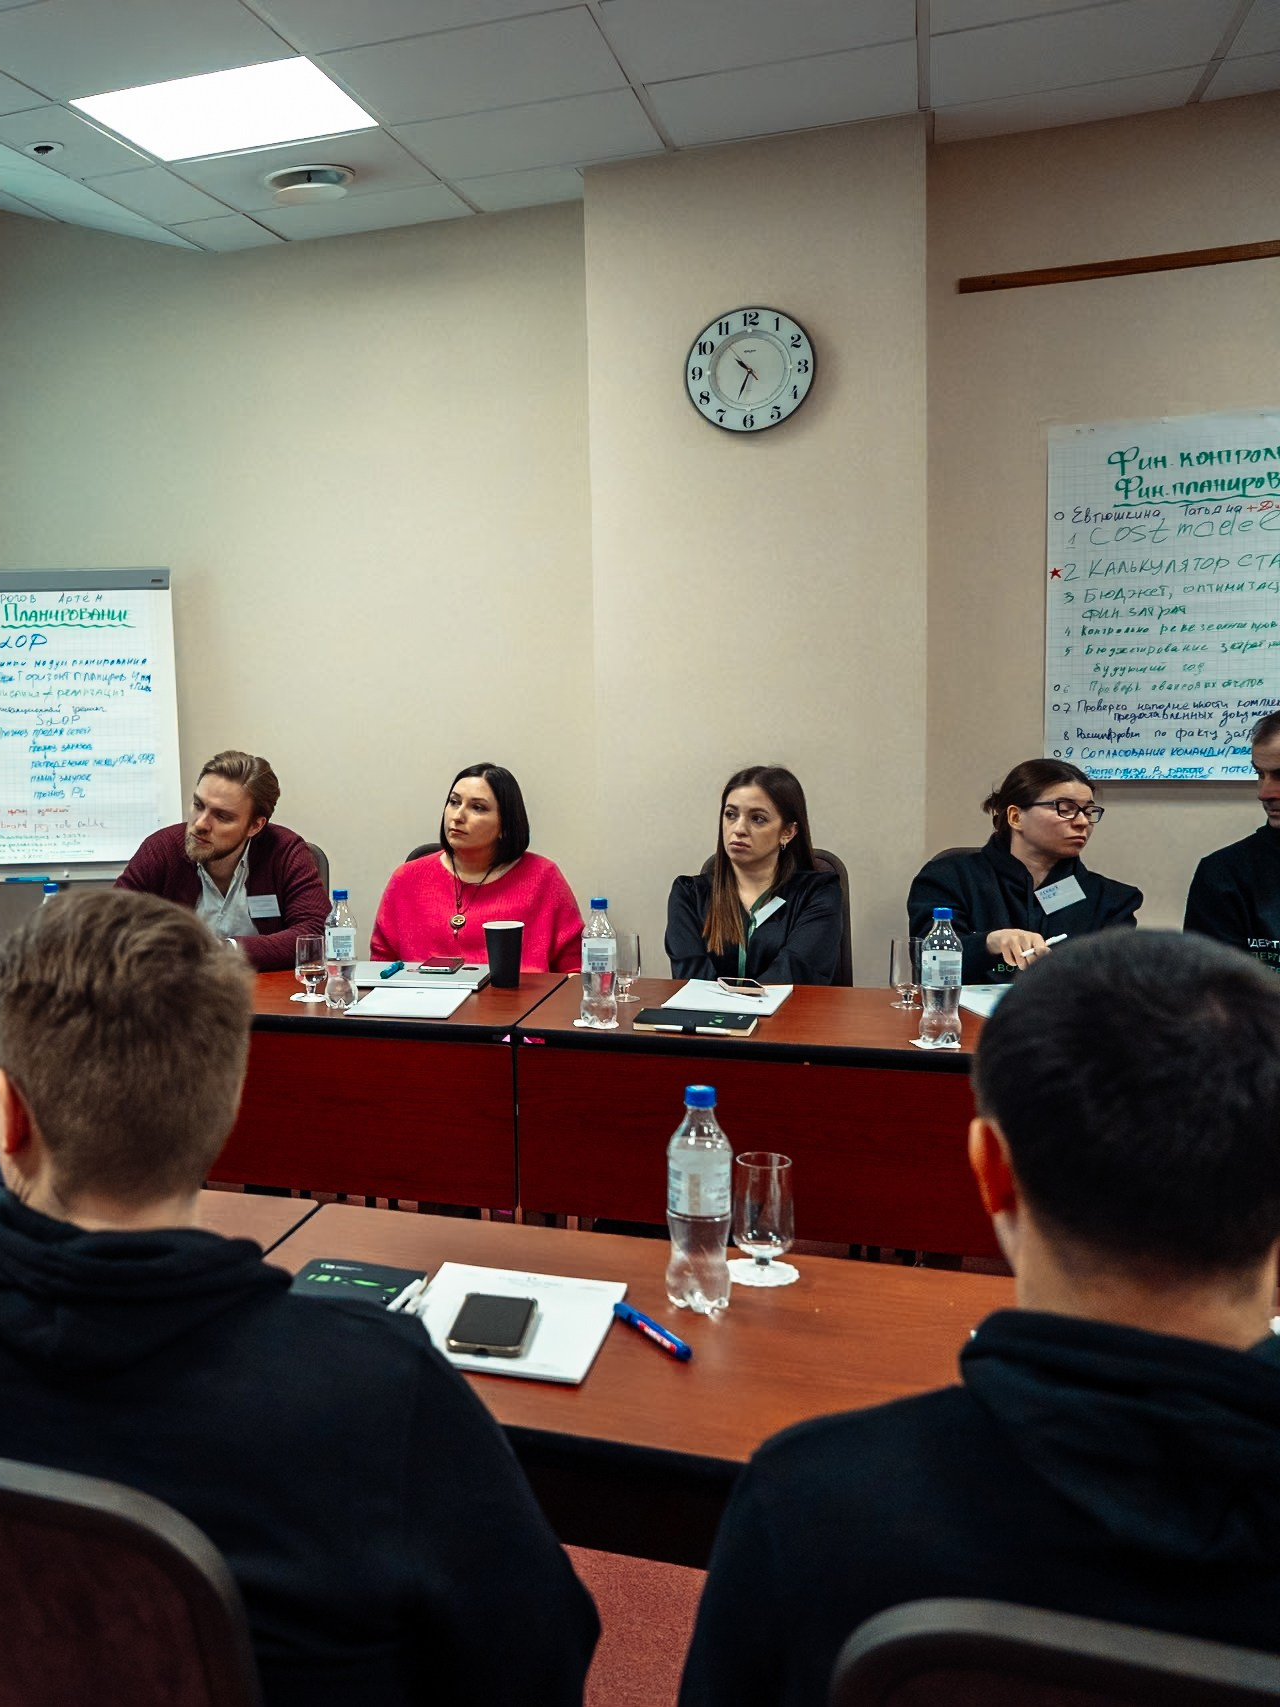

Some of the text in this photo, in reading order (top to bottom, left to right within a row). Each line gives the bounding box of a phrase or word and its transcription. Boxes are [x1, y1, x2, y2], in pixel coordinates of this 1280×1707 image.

[742, 312, 759, 327] 12
[774, 317, 780, 331] 1
[718, 321, 729, 335] 11
[790, 334, 802, 348] 2
[697, 341, 715, 356] 10
[691, 366, 703, 380] 9
[797, 359, 809, 374] 3
[699, 391, 710, 405] 8
[788, 385, 798, 399] 4
[716, 408, 726, 422] 7
[770, 405, 781, 420] 5
[743, 414, 754, 428] 6
[1072, 503, 1242, 524] Евтюшкина Татьяна
[1063, 564, 1080, 581] 2
[1064, 592, 1074, 604] 3
[1063, 731, 1069, 740] 8
[1154, 730, 1167, 738] по
[1064, 747, 1073, 758] 9
